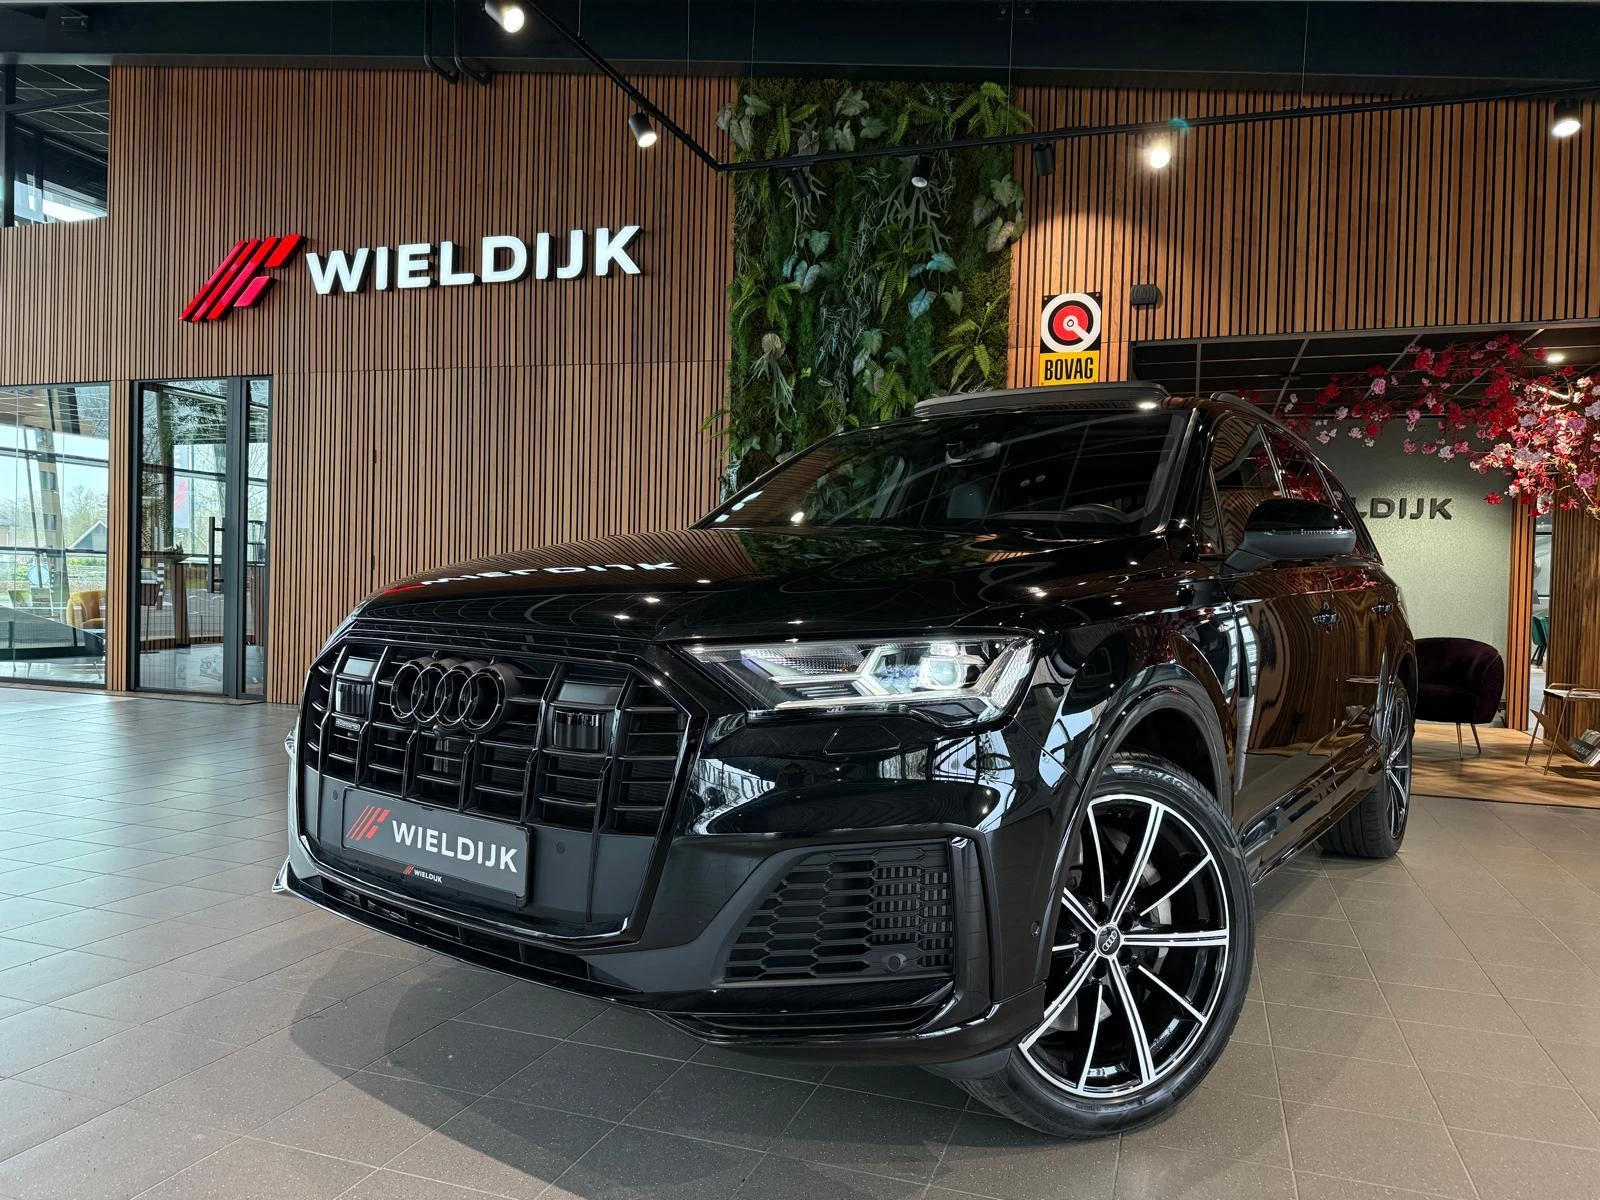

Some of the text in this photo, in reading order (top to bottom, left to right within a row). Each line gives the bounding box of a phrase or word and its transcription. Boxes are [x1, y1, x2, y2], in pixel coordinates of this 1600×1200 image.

[305, 225, 642, 295] WIELDIJK
[1044, 356, 1094, 381] BOVAG
[391, 820, 518, 873] WIELDIJK
[413, 869, 443, 884] WIELDIJK
